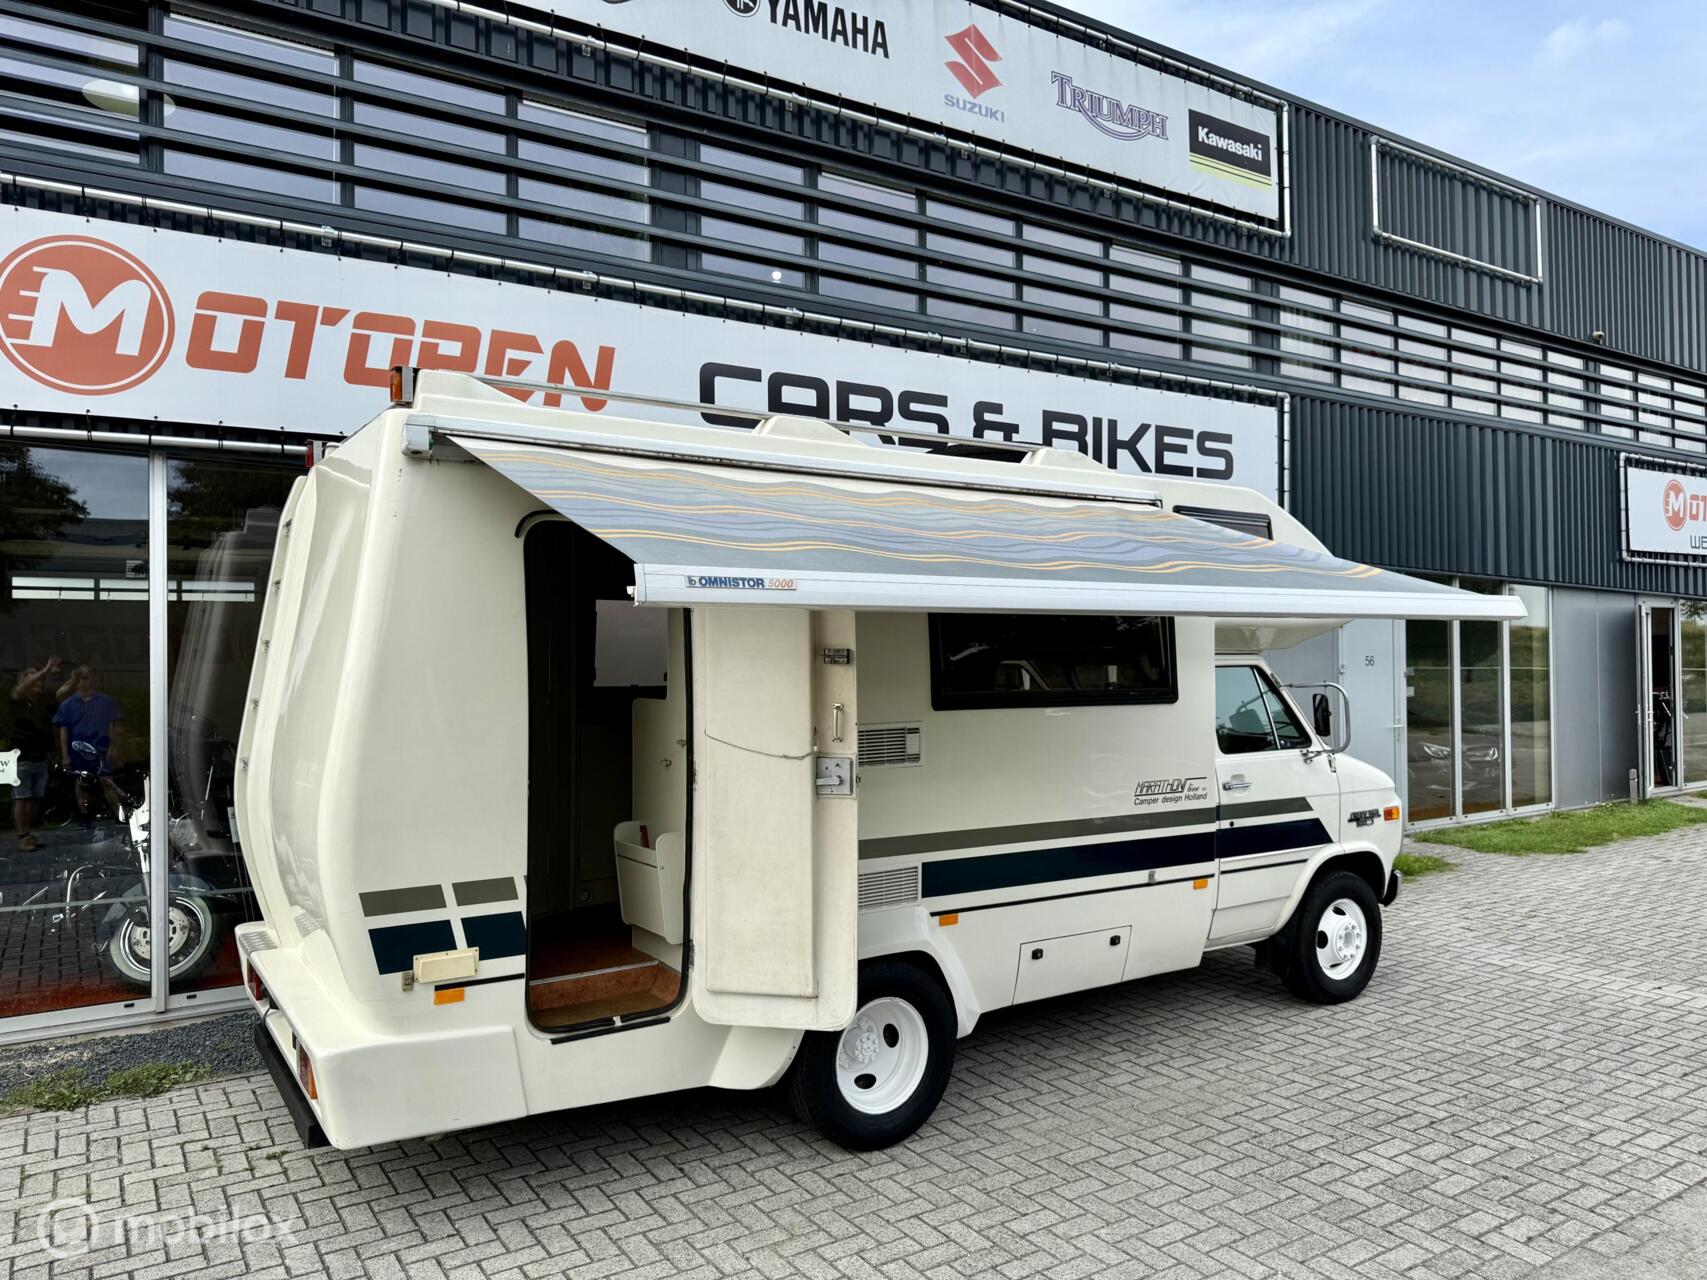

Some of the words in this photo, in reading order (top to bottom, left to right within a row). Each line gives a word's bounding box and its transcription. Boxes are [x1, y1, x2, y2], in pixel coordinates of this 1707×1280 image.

[768, 0, 890, 60] YAMAHA
[944, 94, 1005, 123] SUZUKI
[1051, 71, 1169, 141] TRIUMPH
[1198, 125, 1263, 161] Kawasaki
[699, 361, 950, 449] CARS
[1042, 409, 1234, 481] BIKES
[699, 575, 765, 588] OMNISTOR
[768, 578, 794, 588] 5000
[1364, 655, 1375, 667] 56
[1133, 796, 1160, 806] Camper
[1161, 794, 1183, 804] design
[1184, 792, 1207, 801] Holland
